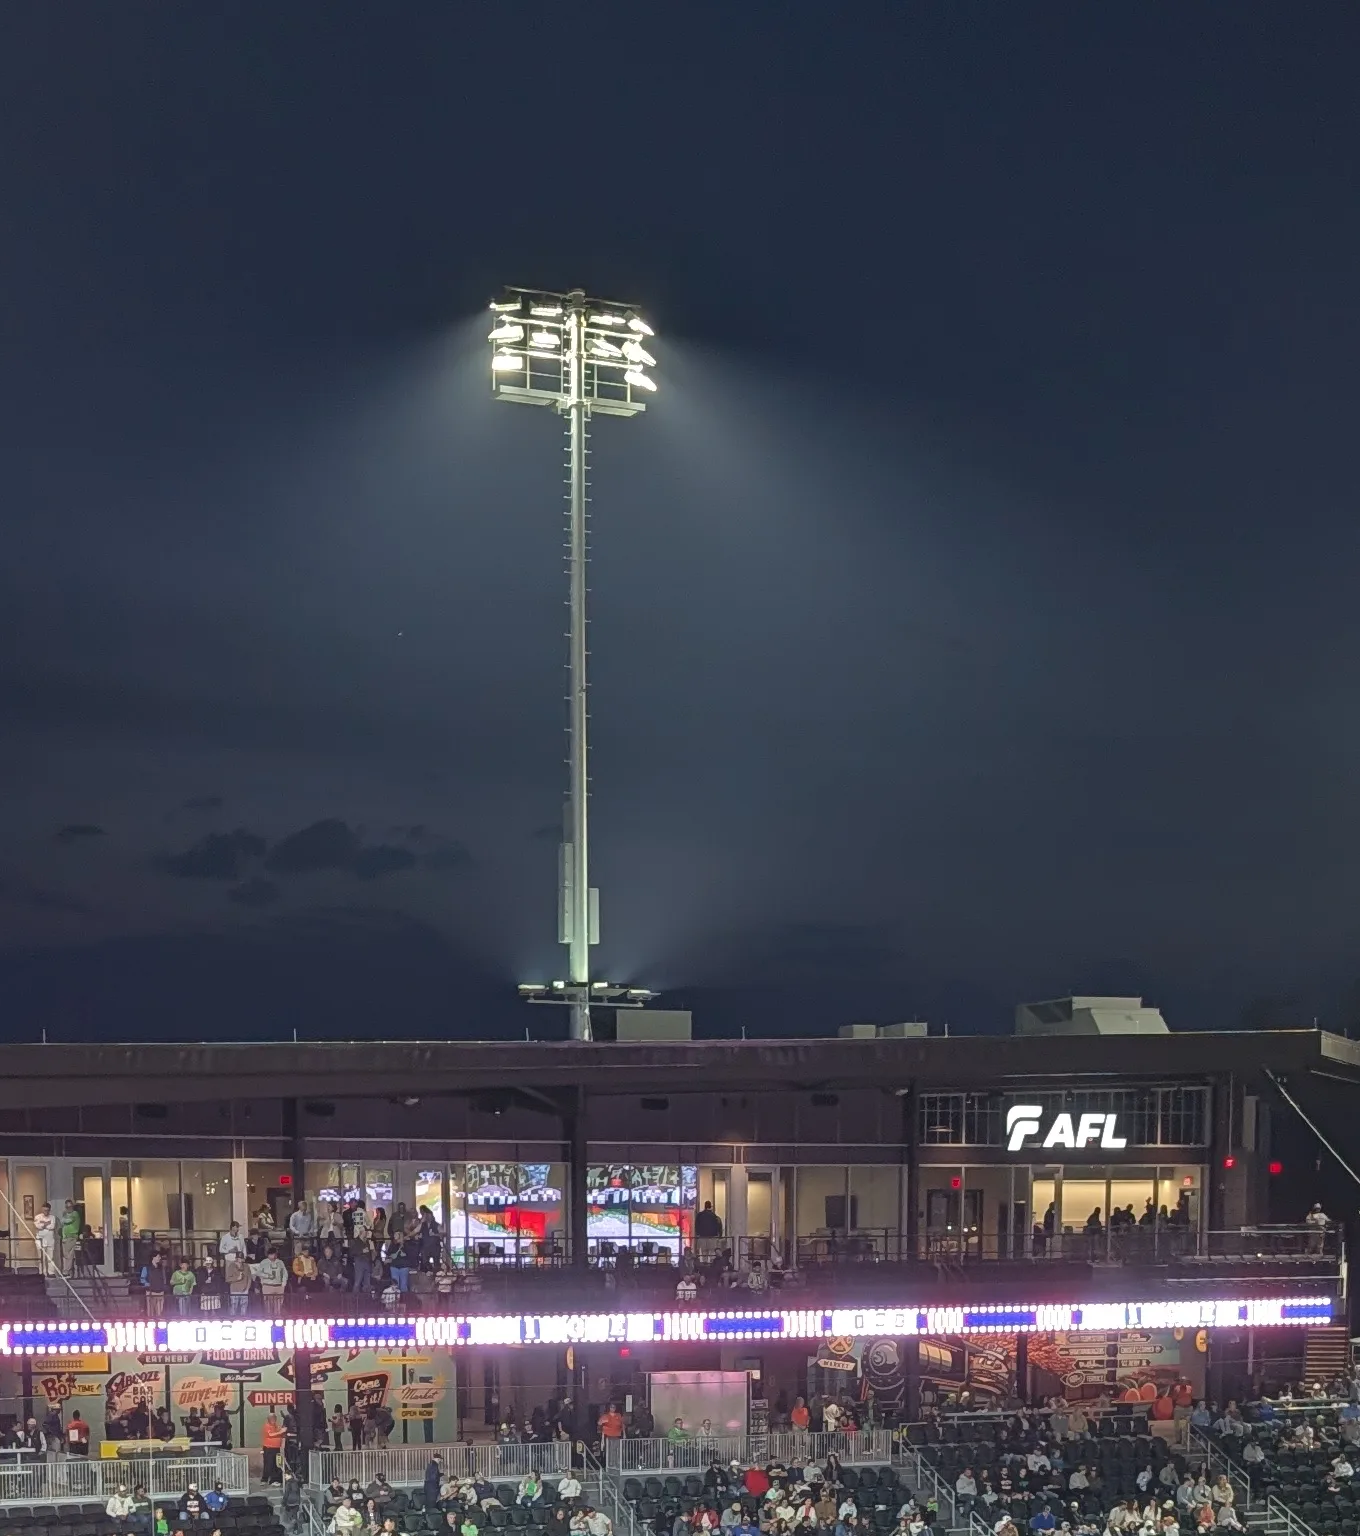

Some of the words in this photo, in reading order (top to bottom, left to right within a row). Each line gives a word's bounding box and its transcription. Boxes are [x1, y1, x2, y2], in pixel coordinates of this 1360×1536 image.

[1042, 1113, 1128, 1149] AFL
[145, 1354, 165, 1363] EAT
[164, 1354, 189, 1363] HERE
[206, 1349, 234, 1361] FOOD
[243, 1349, 276, 1361] DRINK
[132, 1386, 154, 1396] BAR
[182, 1381, 196, 1390] EAT
[354, 1379, 381, 1392] Come
[178, 1384, 229, 1406] DRIVE-IN
[254, 1392, 293, 1404] DINER
[401, 1385, 439, 1401] Market
[401, 1410, 417, 1418] OPEN
[418, 1409, 433, 1417] NOW
